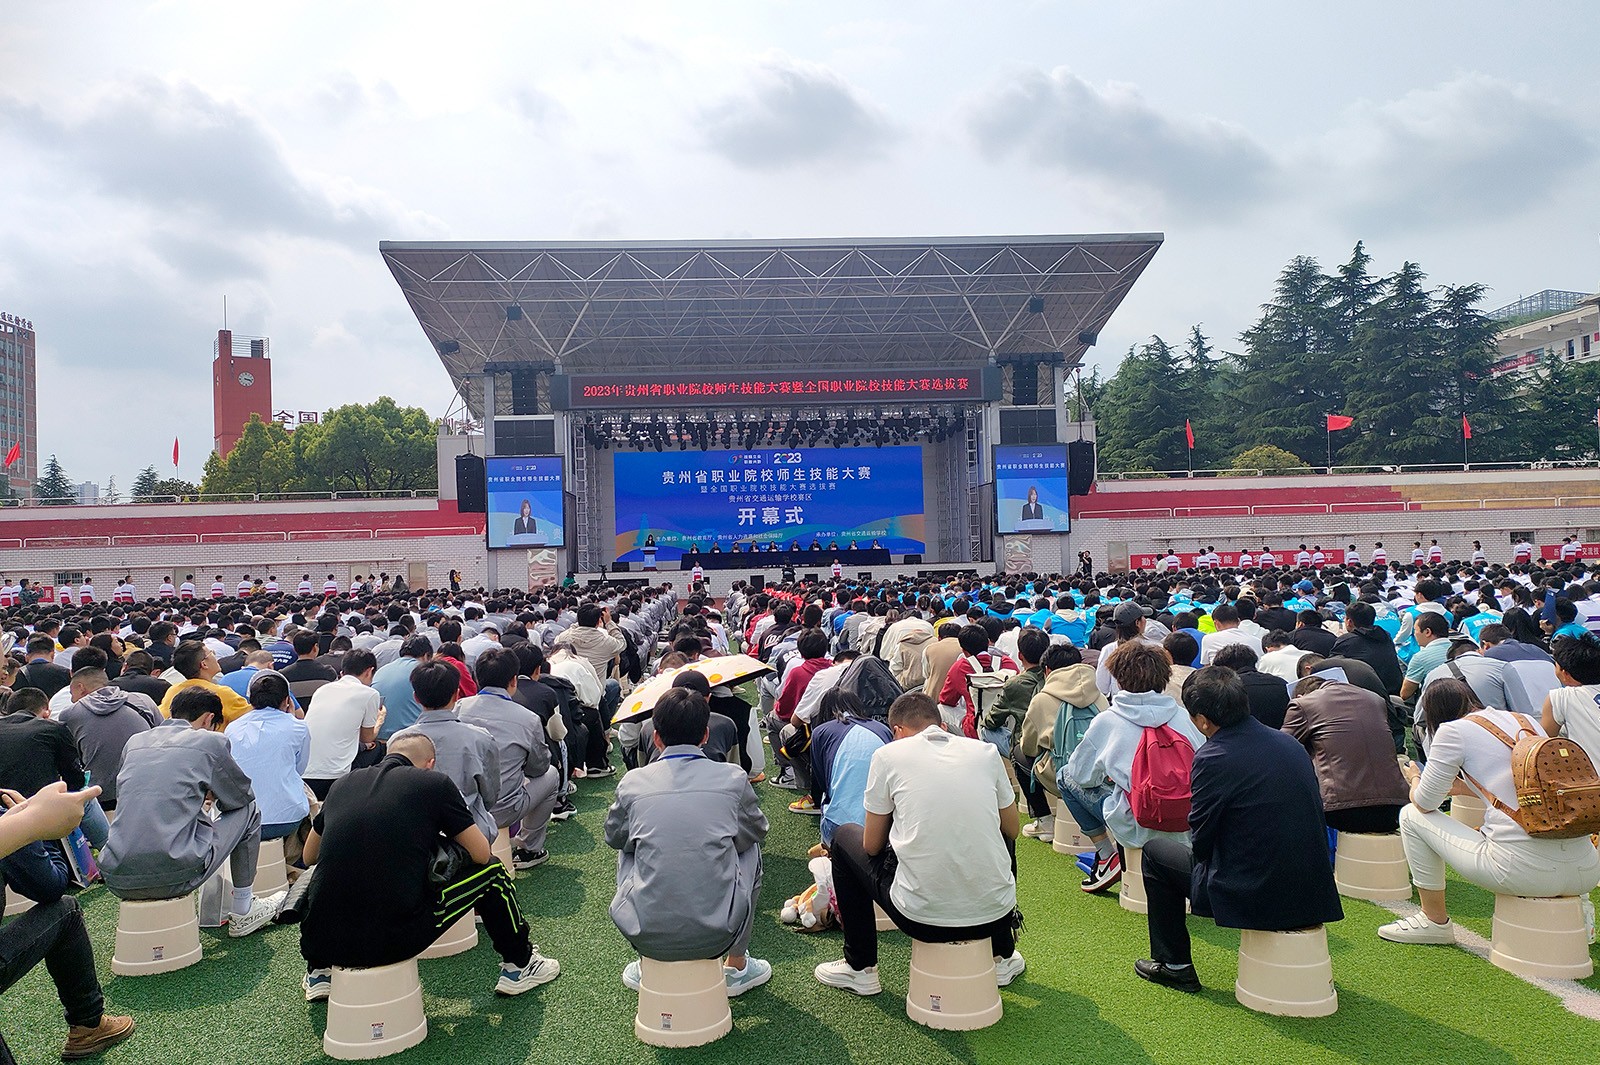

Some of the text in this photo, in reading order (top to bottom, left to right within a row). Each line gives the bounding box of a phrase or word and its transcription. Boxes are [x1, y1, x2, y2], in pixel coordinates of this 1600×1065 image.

[583, 378, 968, 397] 2023年贵州省职业院校师生技能大赛暨全国职业院校技能大赛选拔赛
[661, 466, 871, 485] 贵州省职业院校师生技能大赛
[700, 482, 837, 494] 暨全国职业院校技能大赛选拔赛
[728, 493, 812, 503] 贵州省交通运输学校赛区
[737, 506, 804, 526] 开幕式
